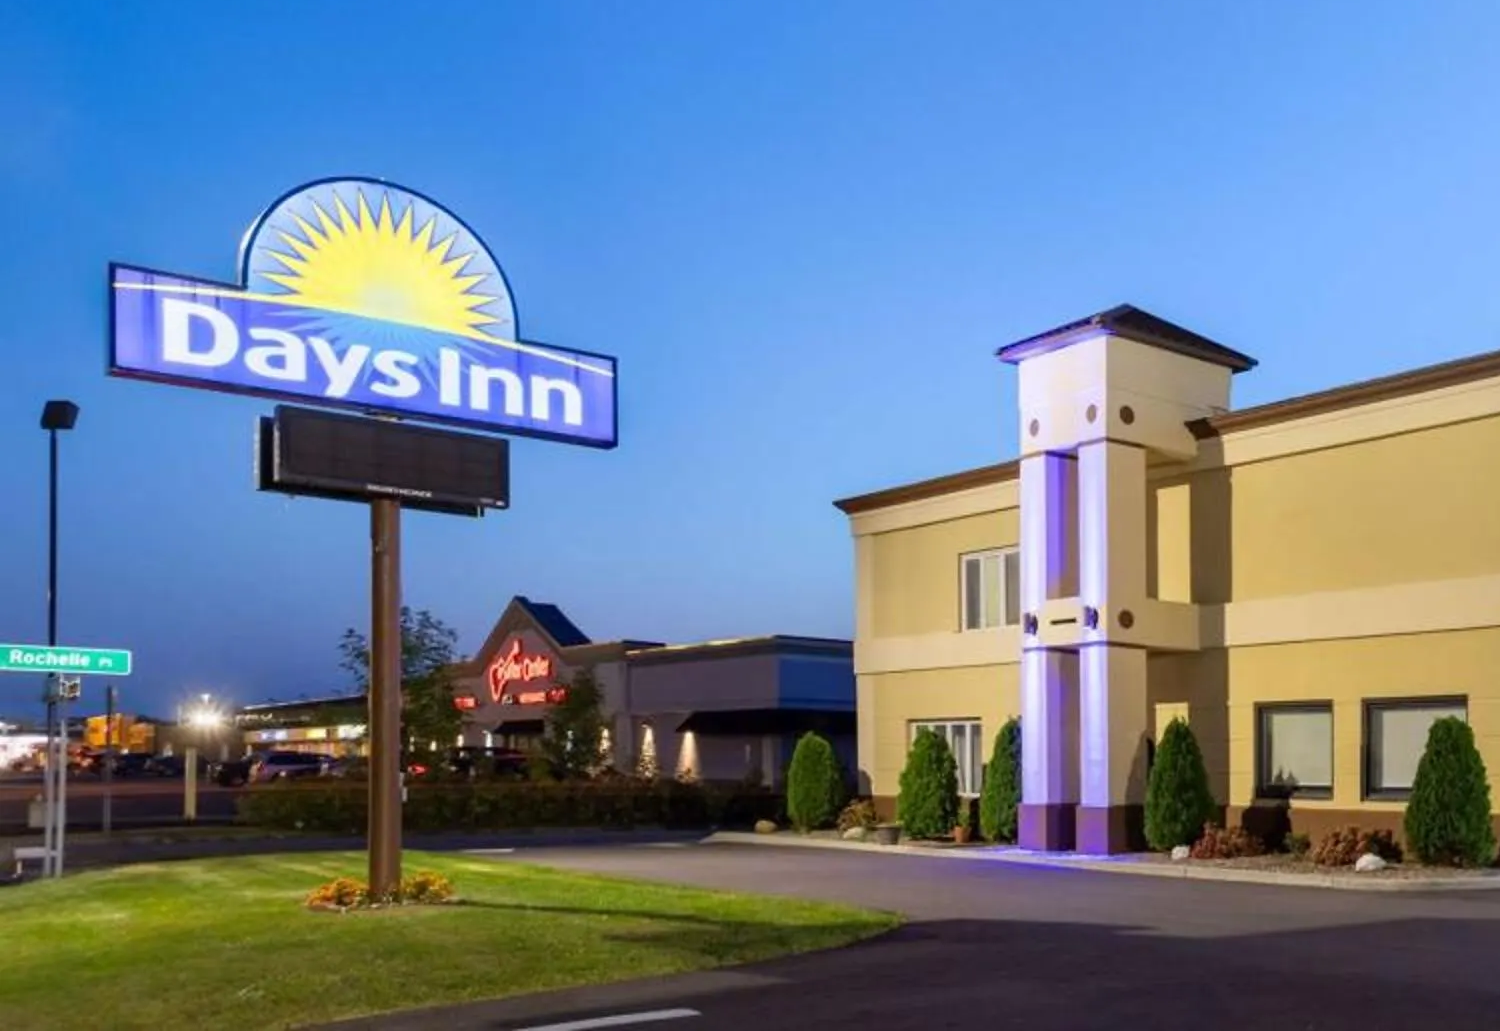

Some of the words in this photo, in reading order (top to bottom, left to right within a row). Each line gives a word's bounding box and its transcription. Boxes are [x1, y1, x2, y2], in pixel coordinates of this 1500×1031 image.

[161, 297, 422, 399] Days
[438, 346, 583, 427] Inn
[9, 649, 91, 667] Rochelle
